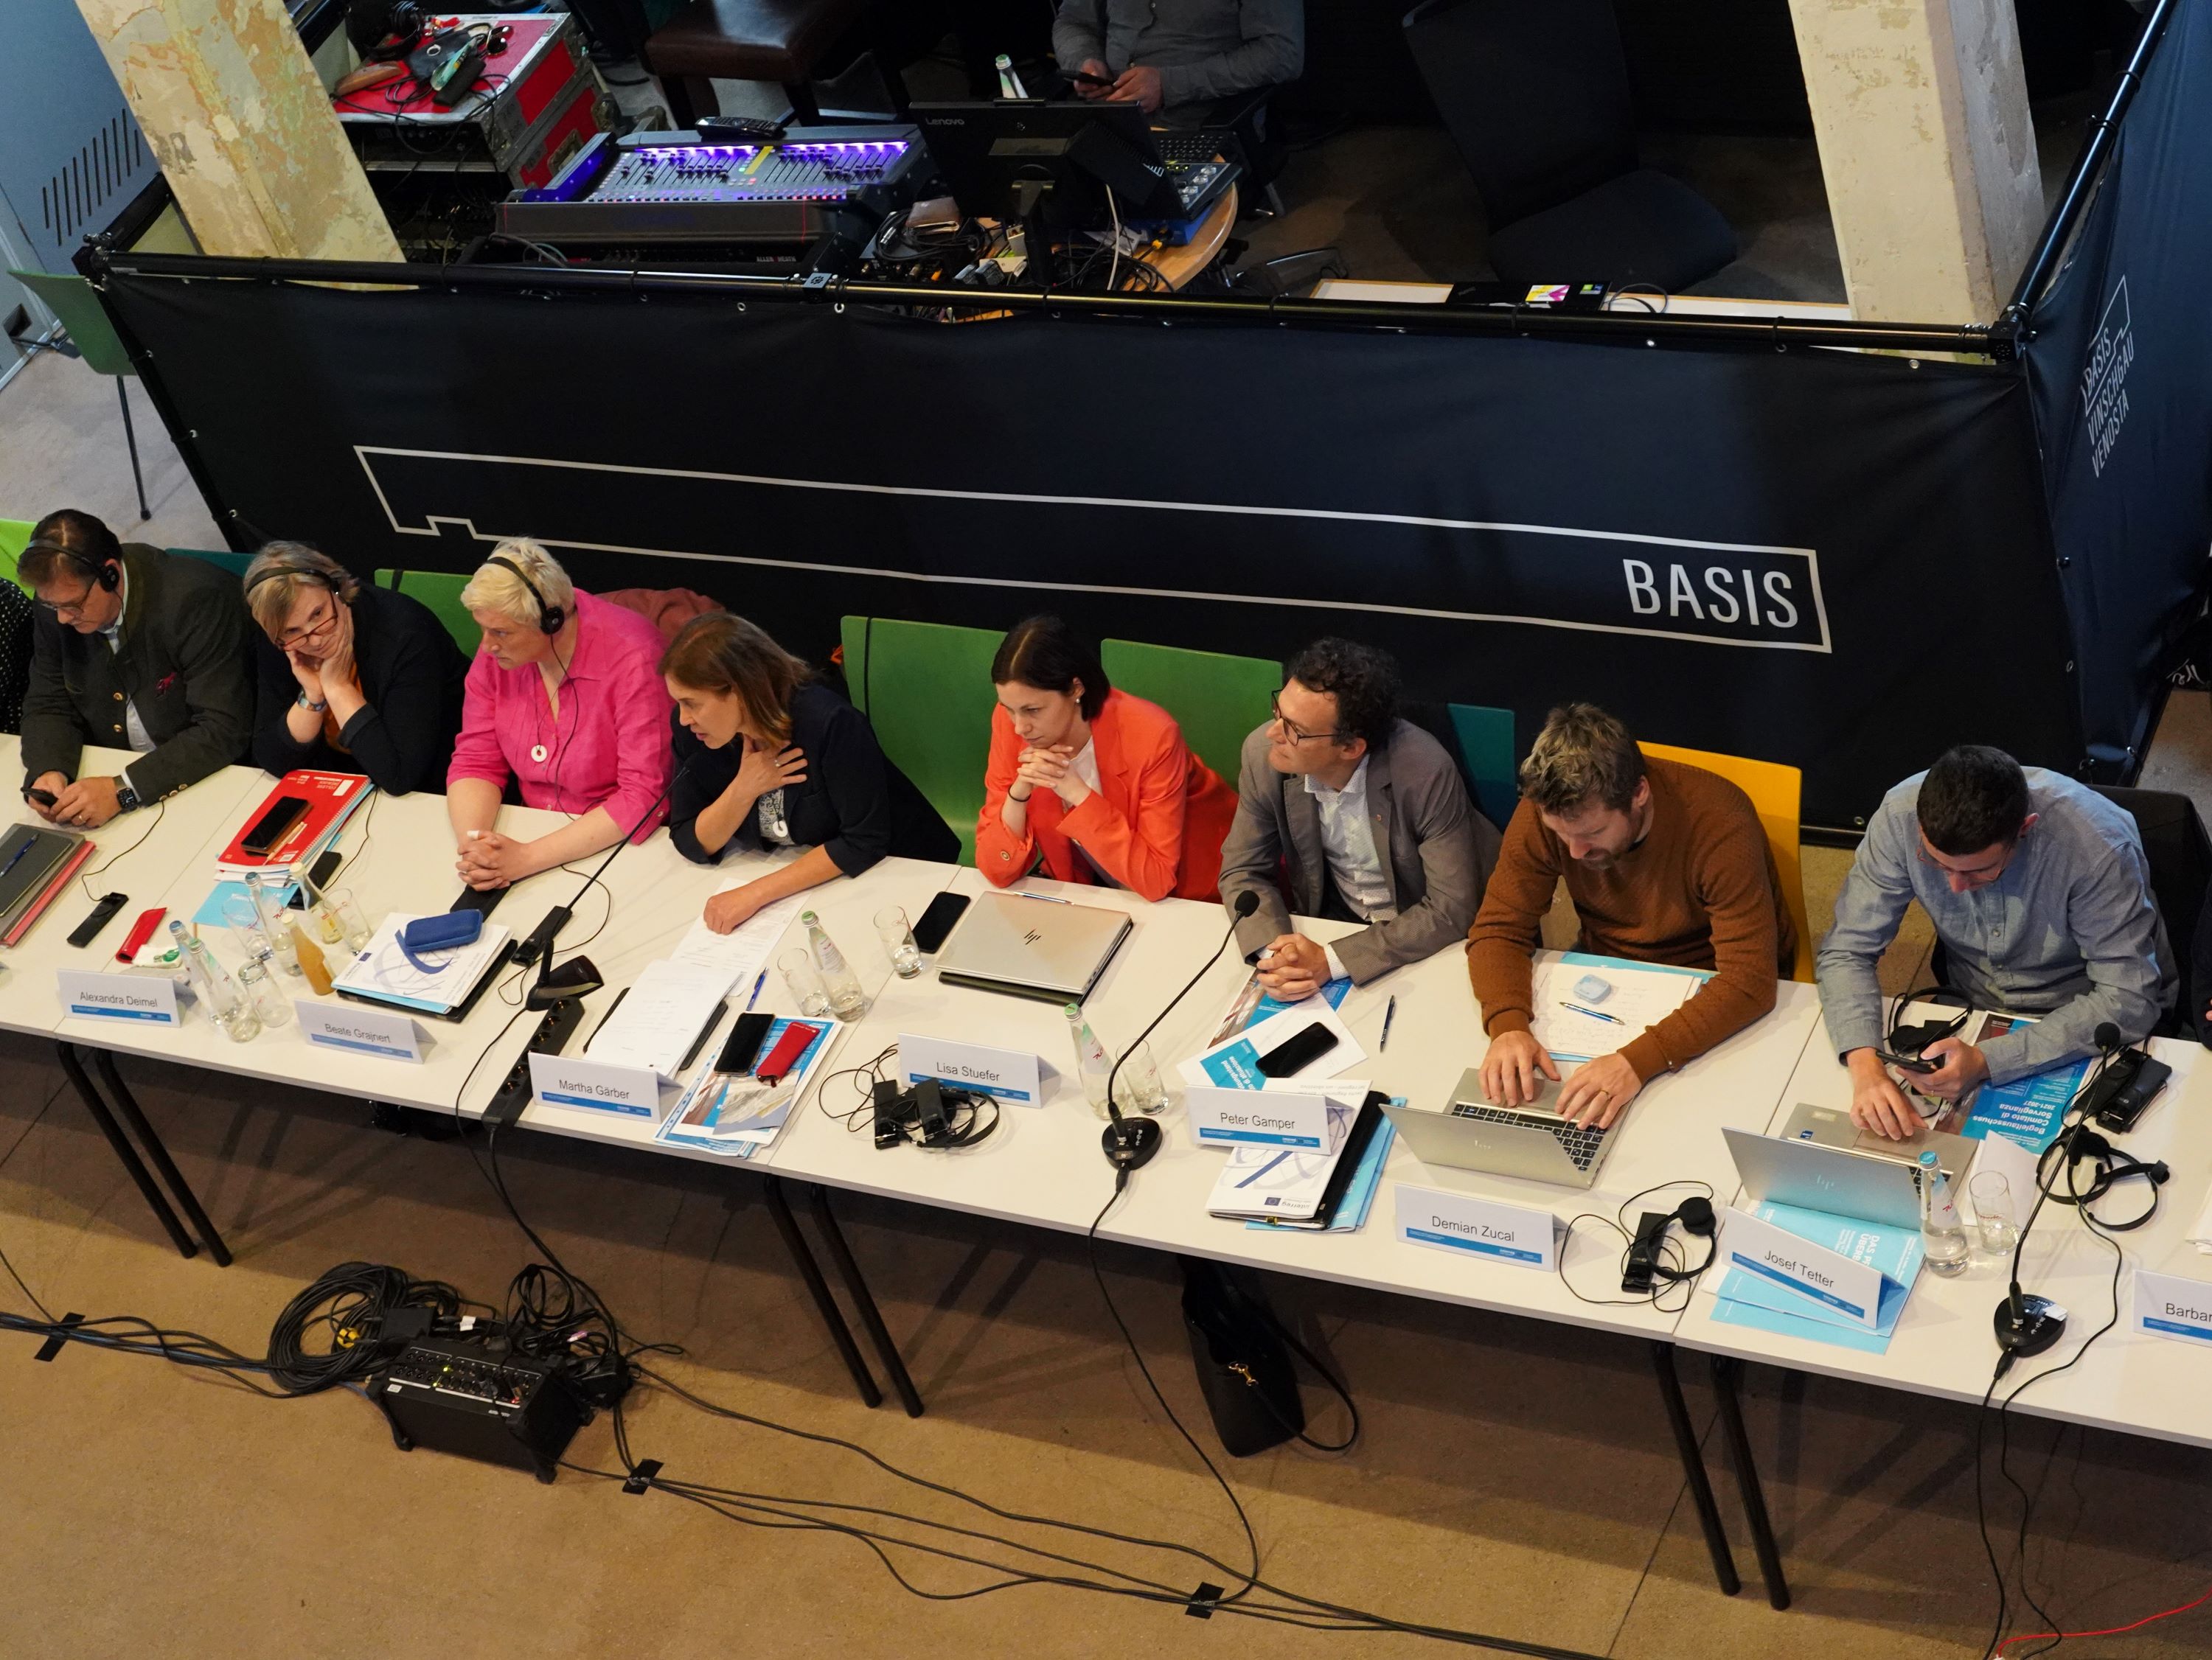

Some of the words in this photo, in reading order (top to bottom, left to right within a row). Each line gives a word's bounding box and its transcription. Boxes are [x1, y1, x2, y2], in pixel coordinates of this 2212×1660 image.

[925, 116, 965, 126] Lenovo
[2082, 327, 2112, 399] BASIS
[2087, 331, 2135, 446] VINSCHGAU
[2091, 388, 2130, 478] VENOSTA
[1622, 559, 1798, 628] BASIS
[80, 991, 125, 1005] Alexandra
[126, 995, 158, 1008] Deimel
[324, 1023, 352, 1037] Beate
[936, 1061, 958, 1075] Lisa
[961, 1066, 1001, 1081] Stuefer
[559, 1079, 593, 1094] Martha
[595, 1085, 630, 1100] Gärber
[1999, 1103, 2053, 1120] Sorveglianza
[2023, 1100, 2056, 1110] 2021-2027
[1220, 1112, 1249, 1126] Peter
[1252, 1115, 1295, 1131] Gamper
[1972, 1115, 2046, 1135] Begleitausschuss
[2011, 1114, 2049, 1126] Comitato
[1432, 1216, 1478, 1235] Demian
[1481, 1225, 1514, 1242] Zucal
[1851, 1232, 1871, 1261] ÜBERB
[1866, 1235, 1881, 1254] DAS
[1764, 1250, 1798, 1271] Josef
[1799, 1263, 1834, 1288] Tetter
